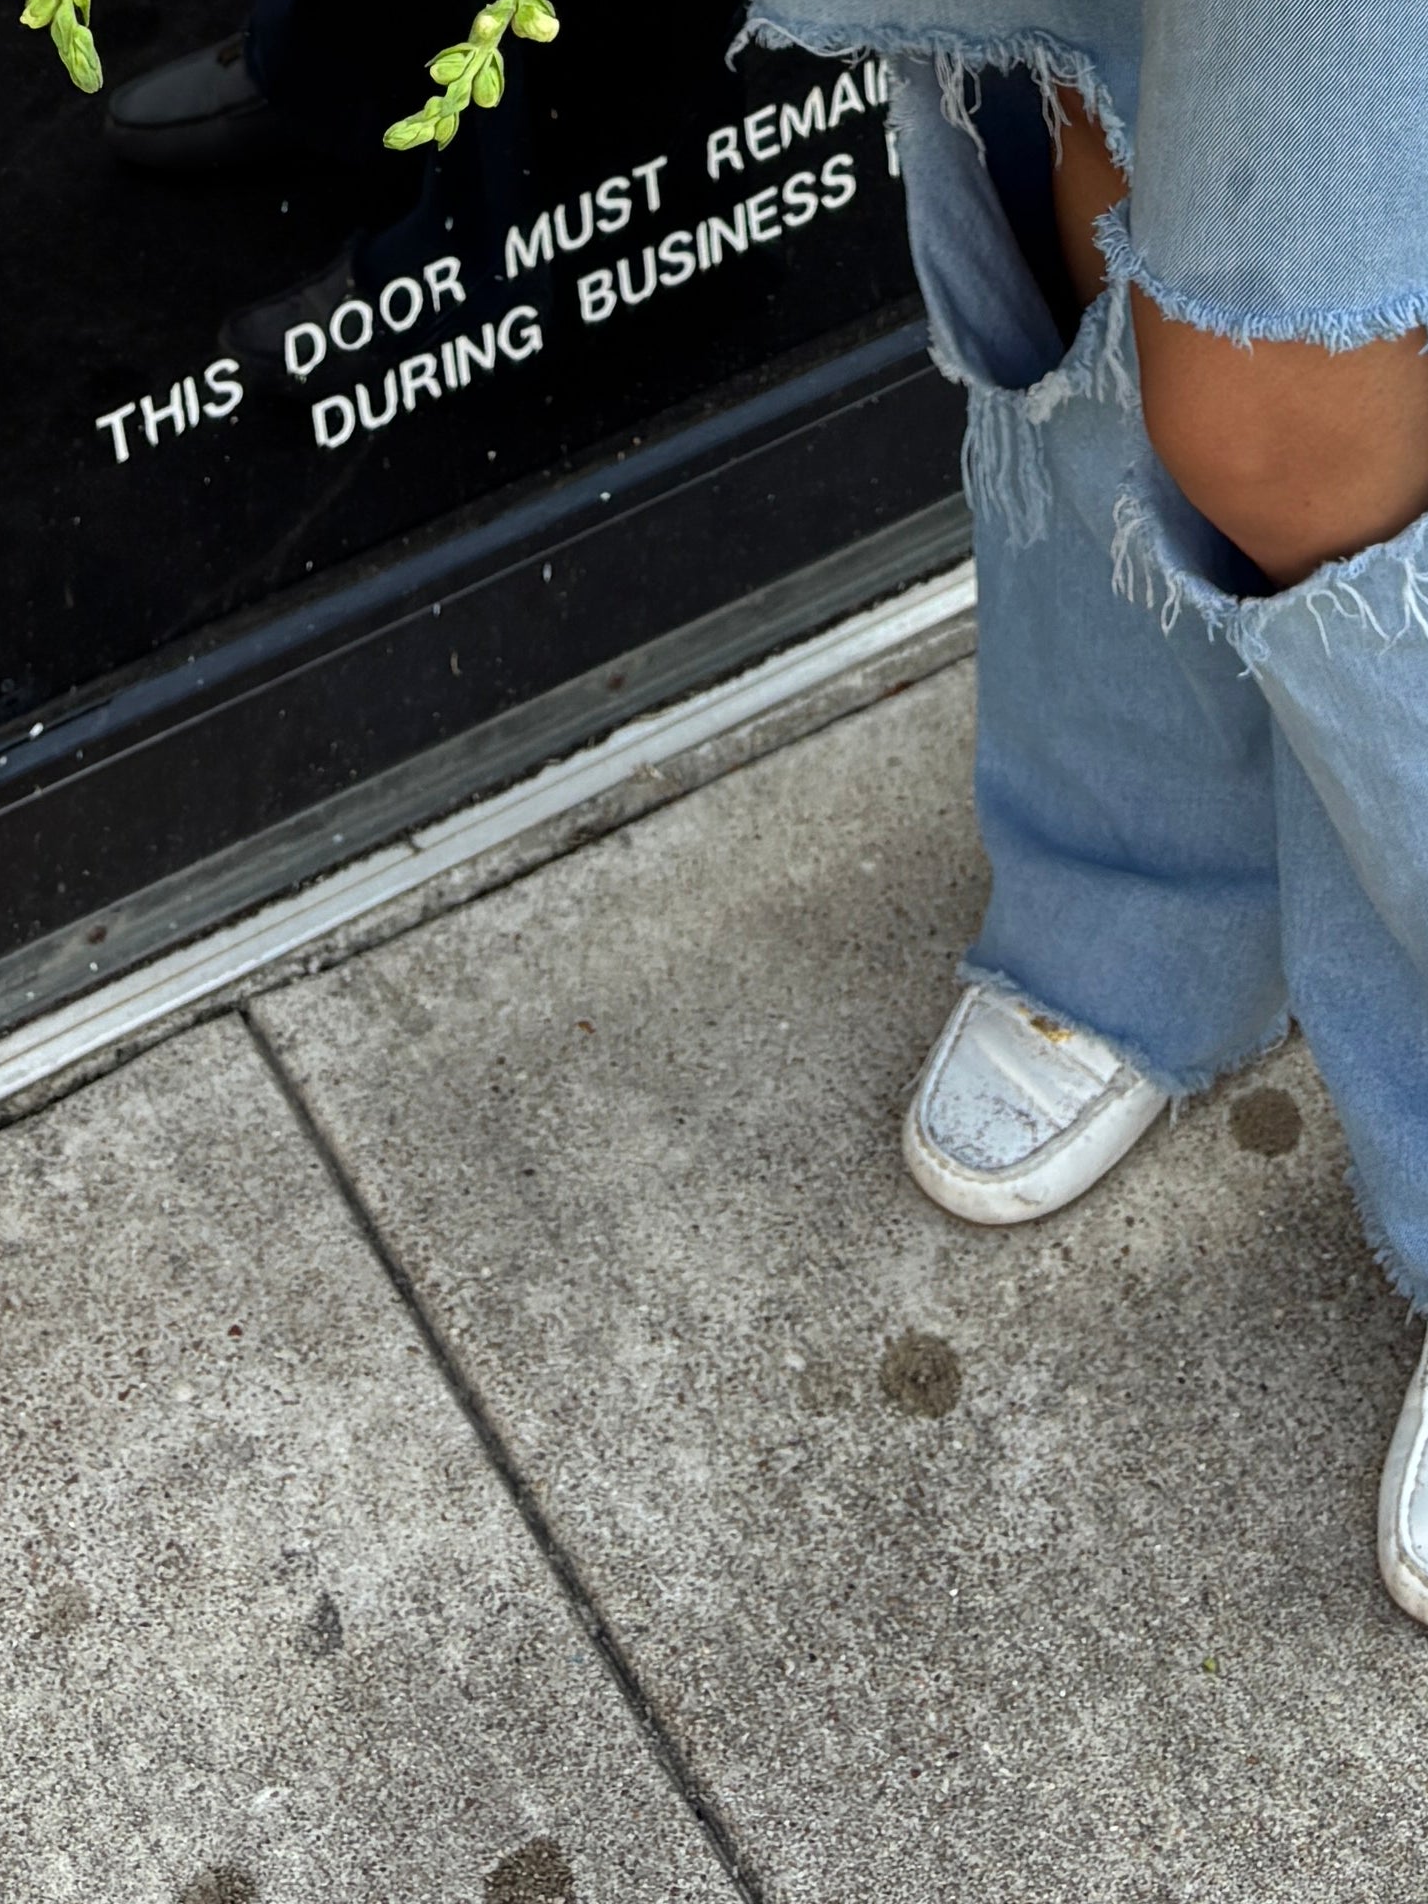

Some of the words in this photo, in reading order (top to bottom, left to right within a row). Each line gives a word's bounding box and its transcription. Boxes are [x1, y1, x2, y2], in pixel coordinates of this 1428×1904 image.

[95, 358, 245, 464] THIS
[283, 255, 467, 379] DOOR
[505, 155, 669, 280] MUST
[312, 304, 545, 451] DURING
[577, 153, 858, 325] BUSINESS
